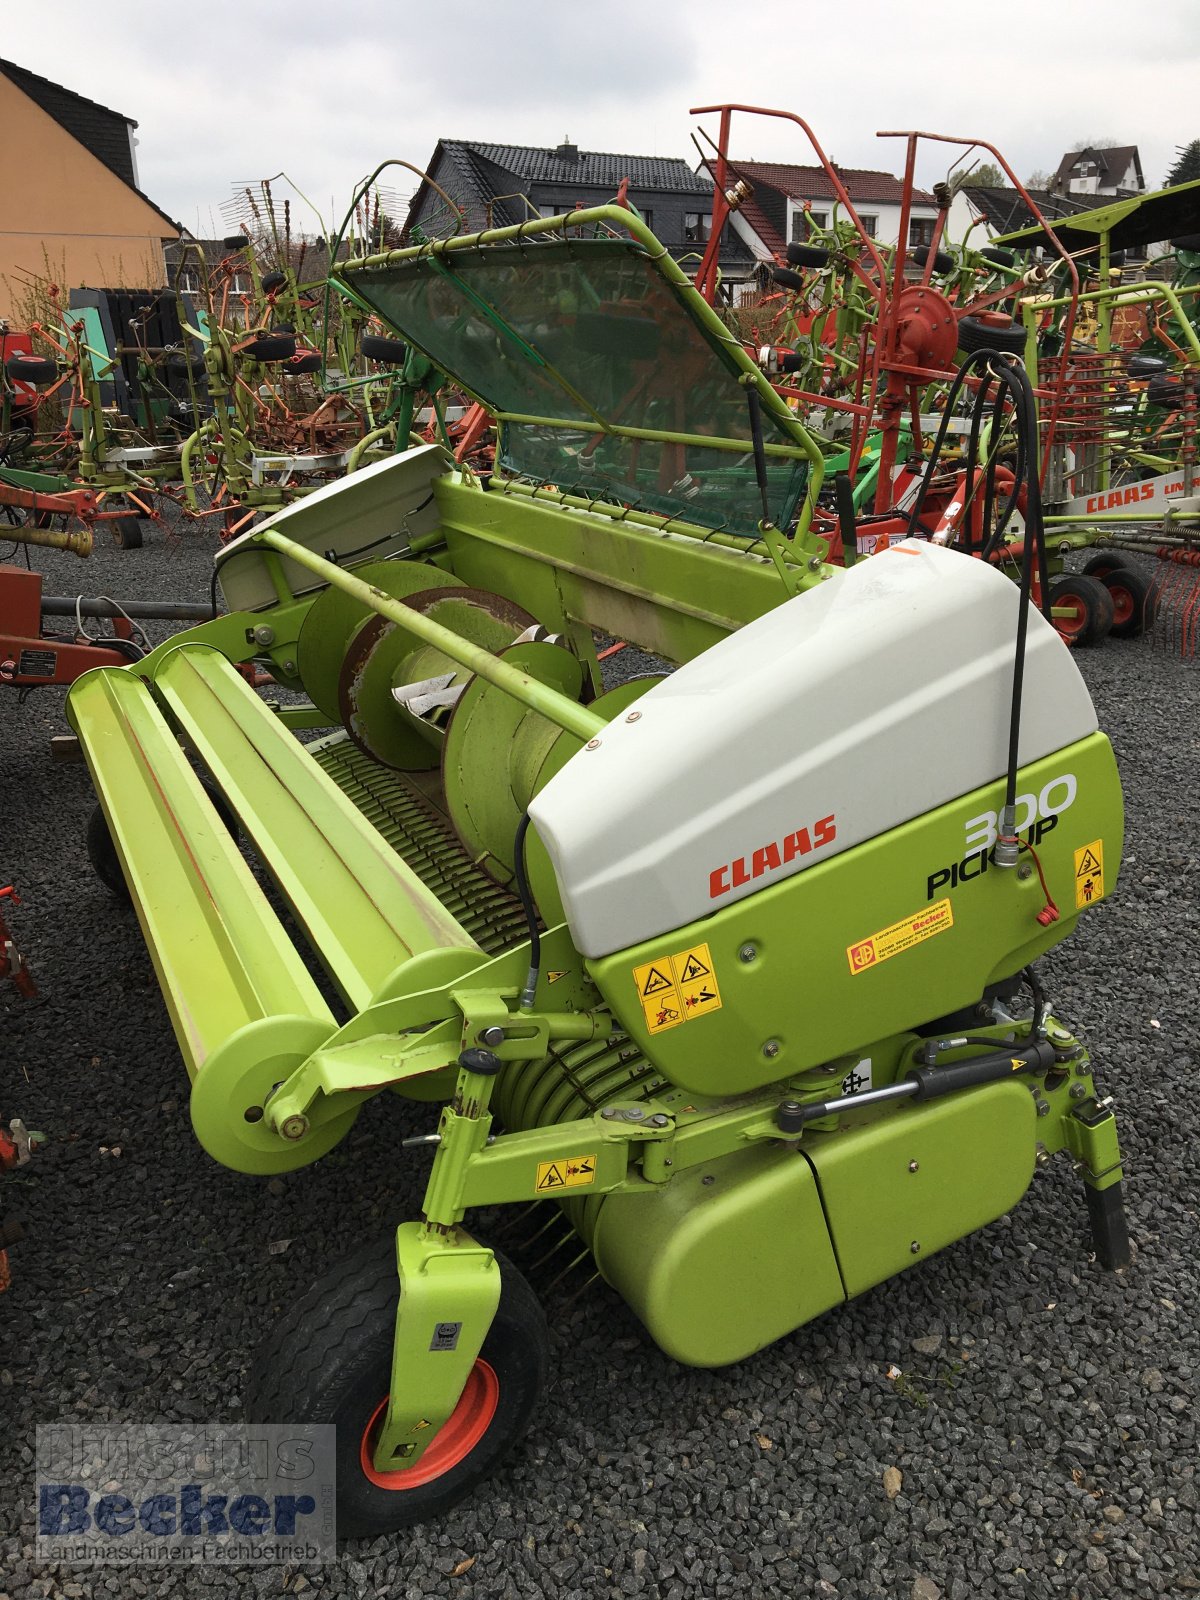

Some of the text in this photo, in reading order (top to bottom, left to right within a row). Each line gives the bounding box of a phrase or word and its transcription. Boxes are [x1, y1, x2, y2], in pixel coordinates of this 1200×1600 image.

[1086, 483, 1155, 514] CLAAS
[965, 773, 1078, 858] 300
[709, 814, 837, 899] CLAAS
[912, 910, 946, 931] Becker
